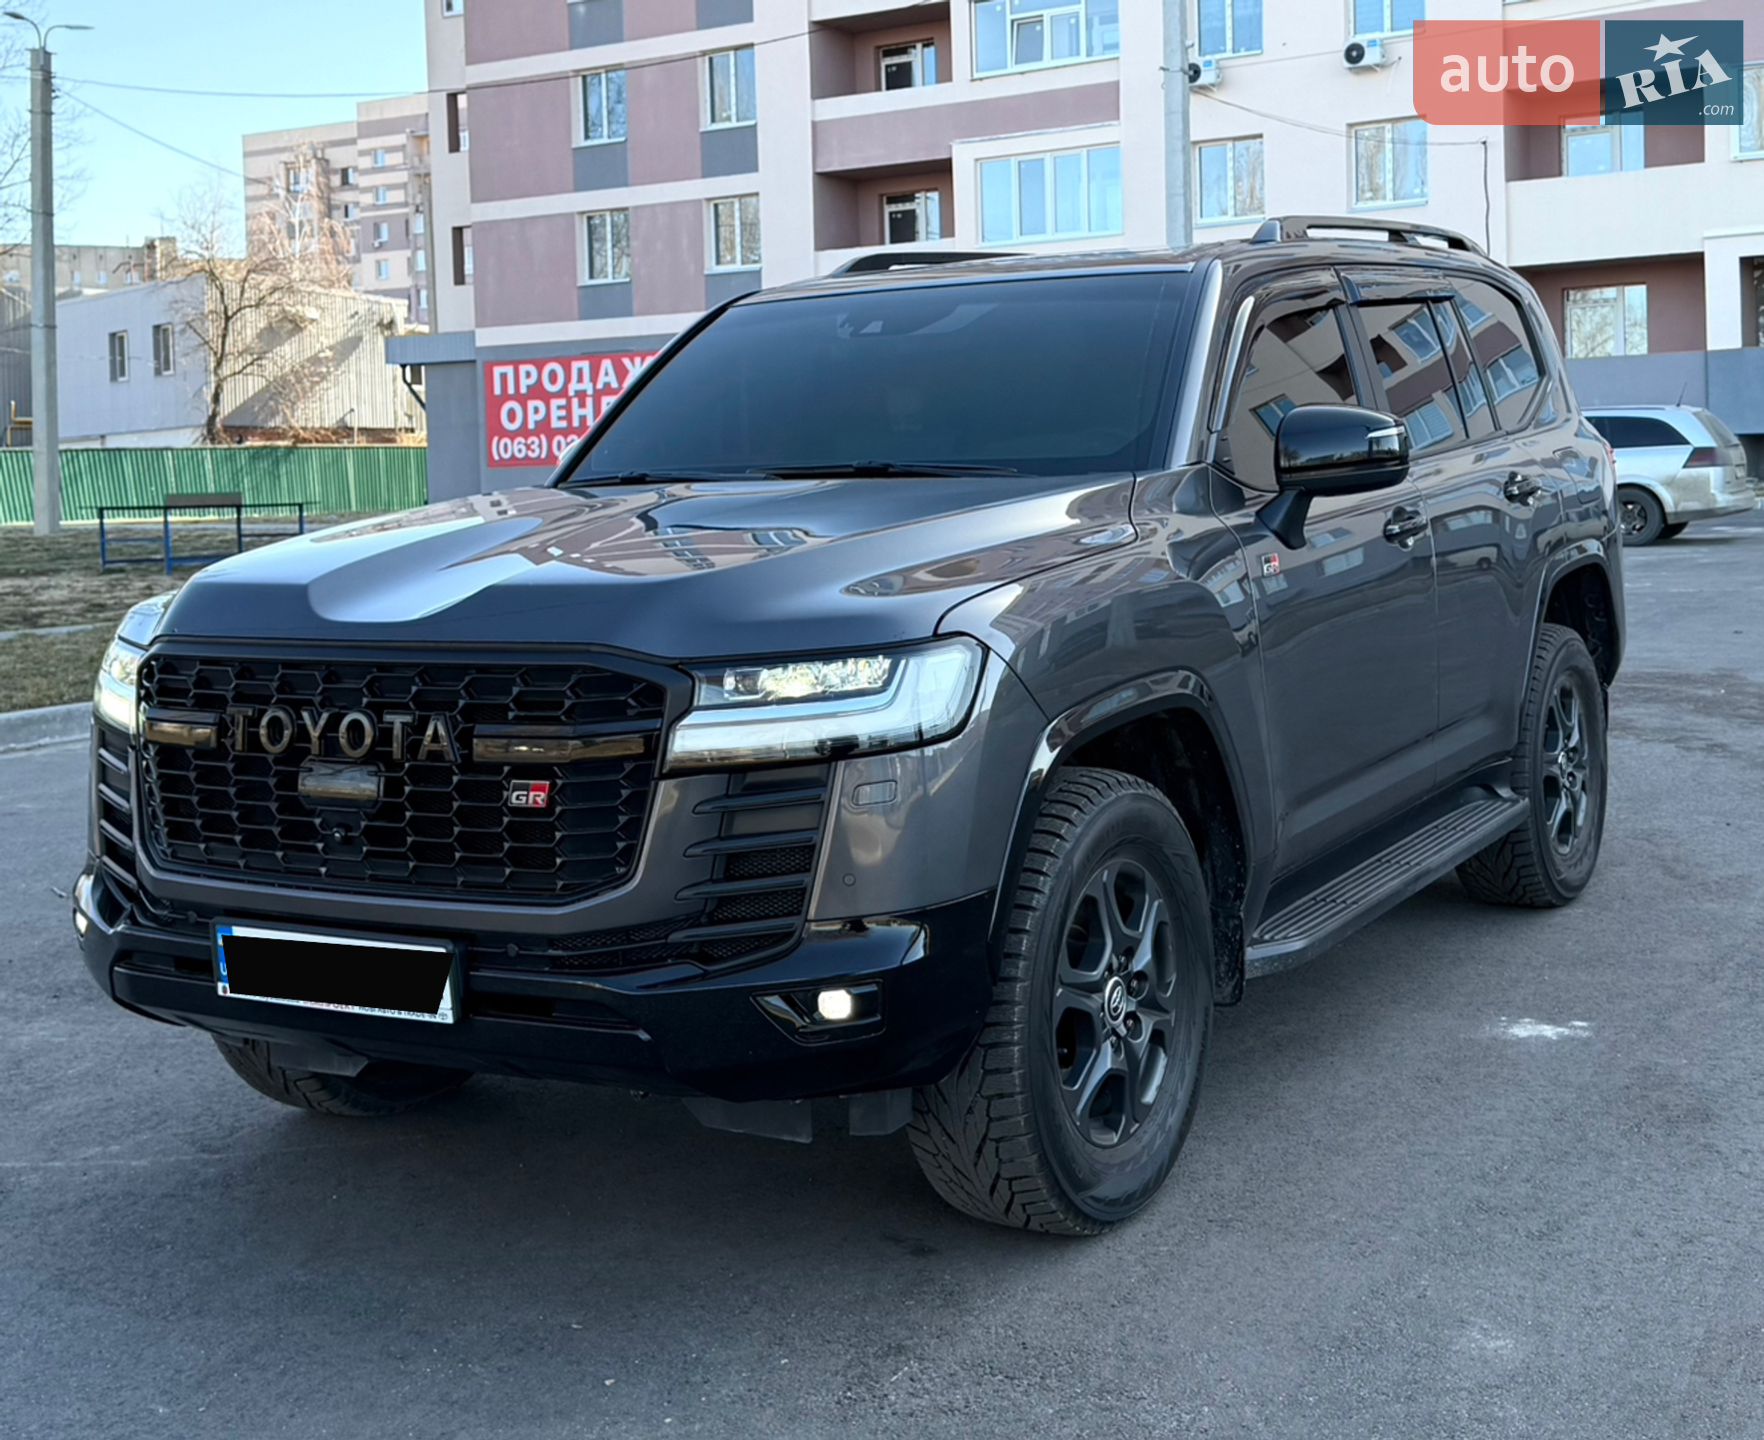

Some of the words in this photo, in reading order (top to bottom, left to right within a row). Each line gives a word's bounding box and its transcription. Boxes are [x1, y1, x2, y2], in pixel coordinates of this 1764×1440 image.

[491, 434, 548, 460] (063)
[226, 704, 460, 764] TOYOTA
[511, 790, 547, 805] GR
